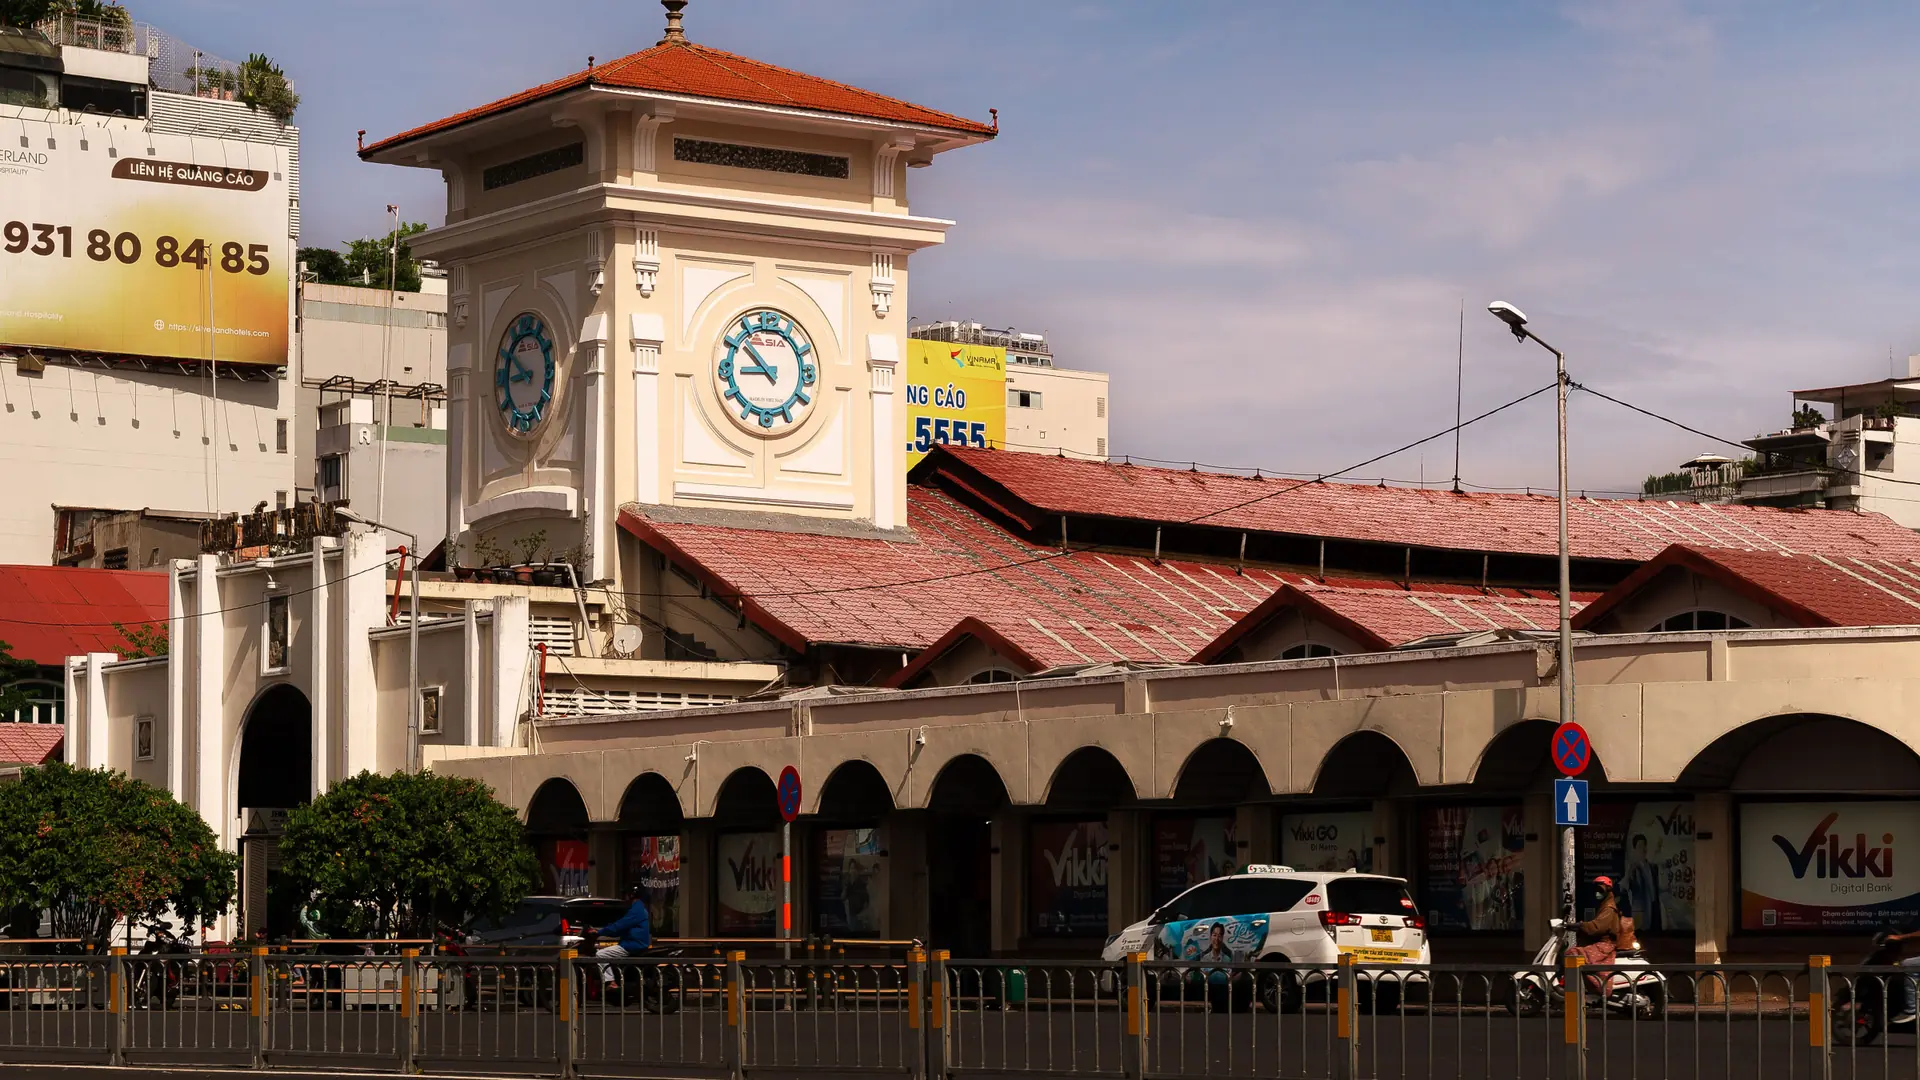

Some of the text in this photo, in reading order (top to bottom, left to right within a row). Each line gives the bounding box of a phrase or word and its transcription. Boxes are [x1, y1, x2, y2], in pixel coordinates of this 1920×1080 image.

[130, 162, 254, 186] LIÊN HỆ QUẢNG CÁO
[86, 228, 142, 265] 80
[155, 235, 208, 270] 84
[220, 241, 270, 276] 85
[759, 311, 781, 331] 12
[906, 383, 965, 409] NG CÁO
[1291, 820, 1338, 841] Vikki GO
[1772, 811, 1895, 879] Vikki
[1831, 883, 1893, 895] Digital Bank
